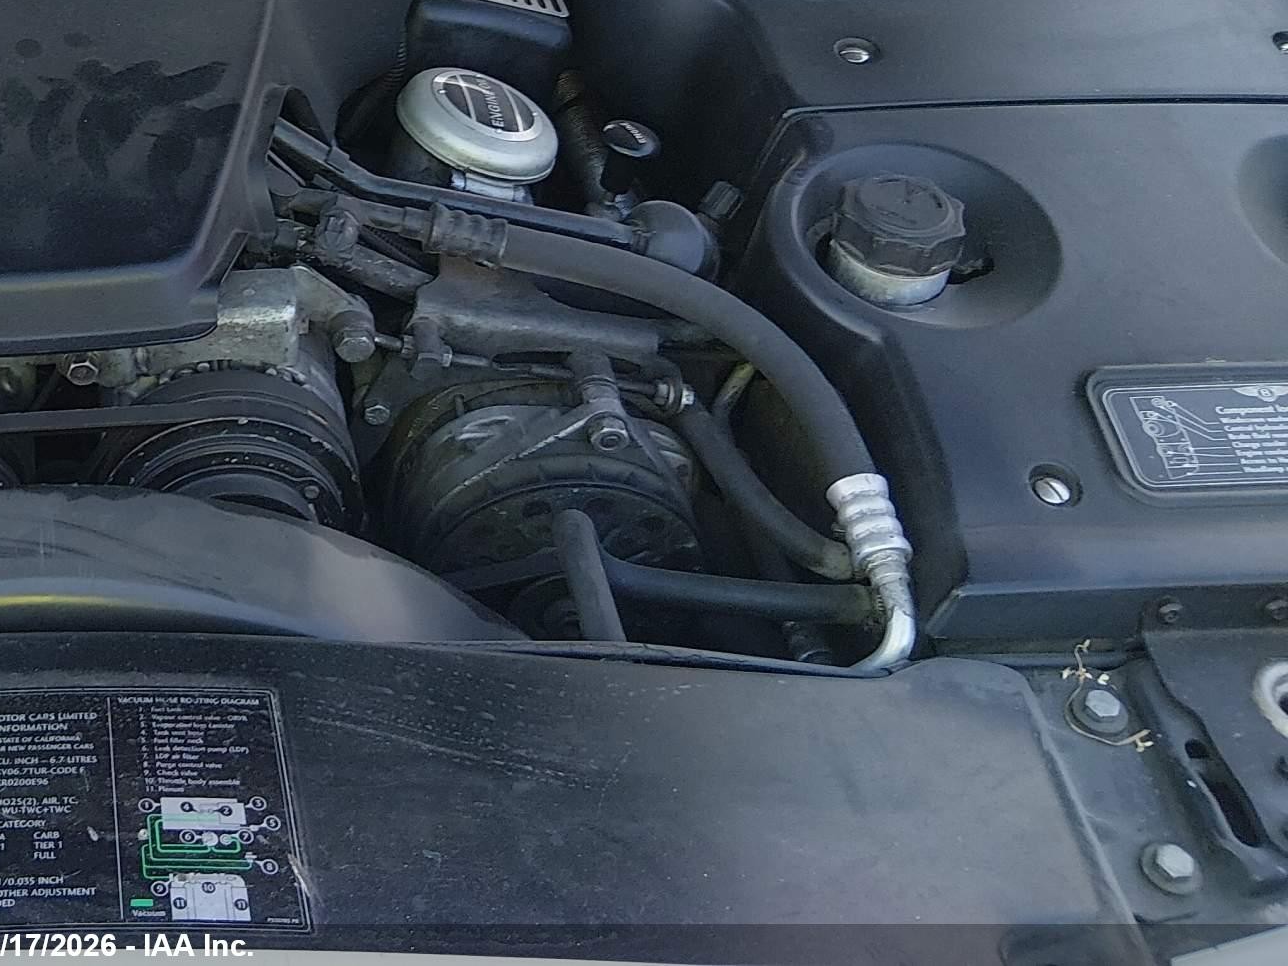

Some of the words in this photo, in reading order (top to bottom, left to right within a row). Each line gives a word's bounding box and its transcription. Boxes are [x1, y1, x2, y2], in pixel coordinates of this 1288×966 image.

[117, 696, 153, 704] VACUUM
[220, 697, 260, 705] DIAGRAM
[28, 713, 55, 722] CARS
[58, 712, 98, 721] LIMITED
[34, 734, 81, 743] CALIFORNIA
[7, 744, 25, 752] NEW
[27, 743, 72, 751] PASSENGER
[73, 742, 94, 750] CARS
[14, 756, 39, 765] INCH
[67, 755, 98, 764] LITRES
[33, 831, 60, 840] CARB
[0, 842, 5, 851] 1
[34, 841, 56, 850] TIER
[57, 840, 63, 849] 1
[33, 851, 57, 860] FULL
[37, 876, 64, 885] INCH
[31, 886, 97, 898] ADJUSTMENT
[131, 909, 166, 917] Vacuum
